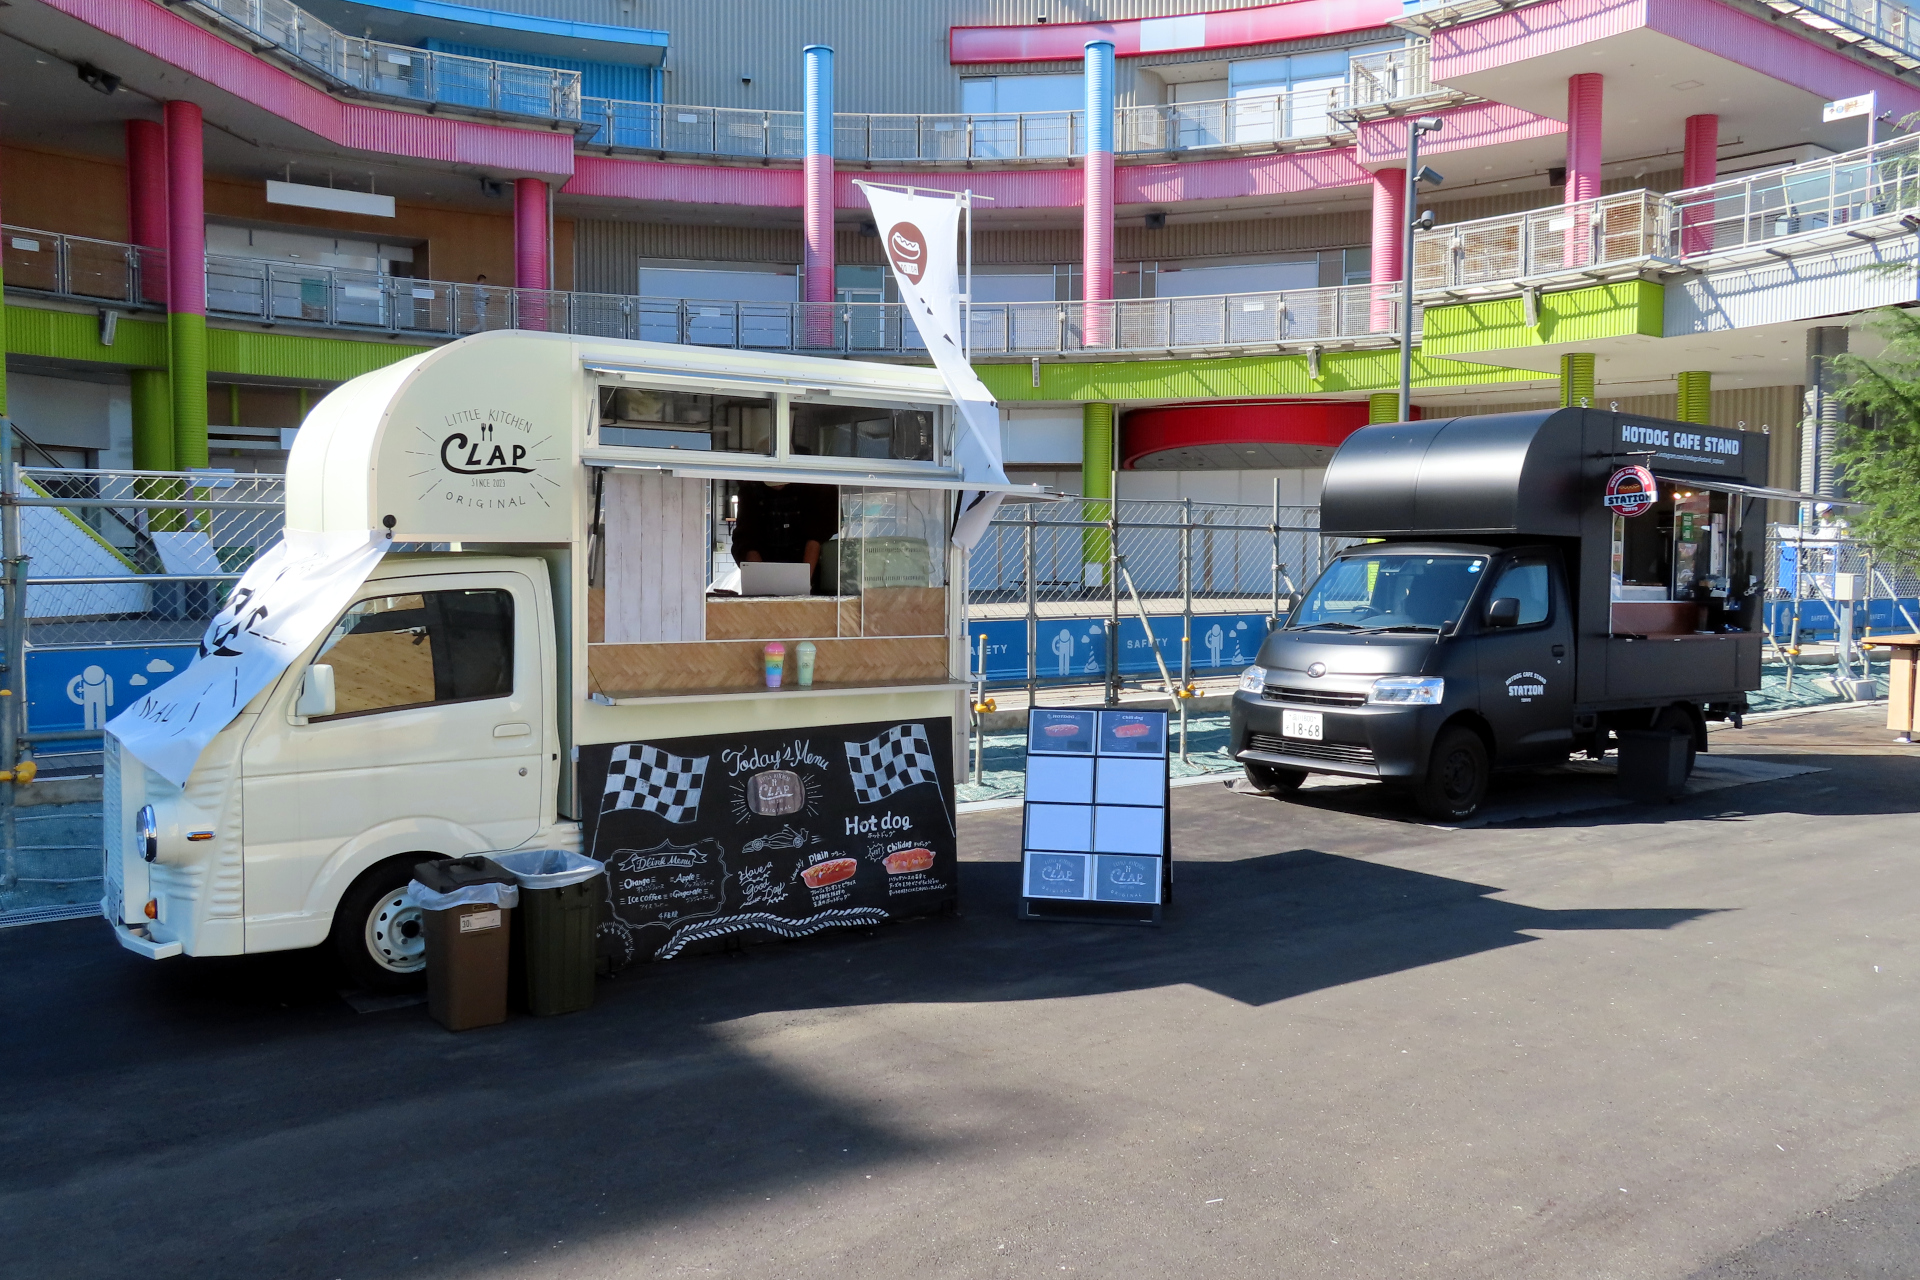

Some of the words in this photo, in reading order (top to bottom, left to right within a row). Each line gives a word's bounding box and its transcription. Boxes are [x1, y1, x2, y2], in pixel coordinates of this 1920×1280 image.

[445, 409, 481, 427] LITTLE
[488, 409, 533, 433] KITCHEN
[1622, 425, 1669, 446] HOTDOG
[1673, 432, 1701, 450] CAFE
[1704, 436, 1740, 455] STAND
[440, 432, 537, 475] CLAP
[471, 478, 490, 488] SINCE
[492, 478, 506, 488] 2023
[445, 491, 526, 509] ORIGINAL
[1608, 493, 1652, 505] STATION
[1508, 684, 1544, 697] STATION
[1292, 722, 1321, 738] 18-68
[721, 743, 794, 777] Today's
[789, 738, 830, 771] Menu
[758, 783, 794, 801] CLAP
[845, 814, 878, 836] Hot
[881, 811, 914, 831] dog
[667, 855, 692, 866] Menu
[808, 850, 829, 865] Plain
[674, 873, 696, 884] Apple
[1041, 865, 1076, 882] CLAP
[1110, 868, 1147, 886] CLAP
[624, 878, 651, 890] Orange
[628, 895, 640, 905] Ice
